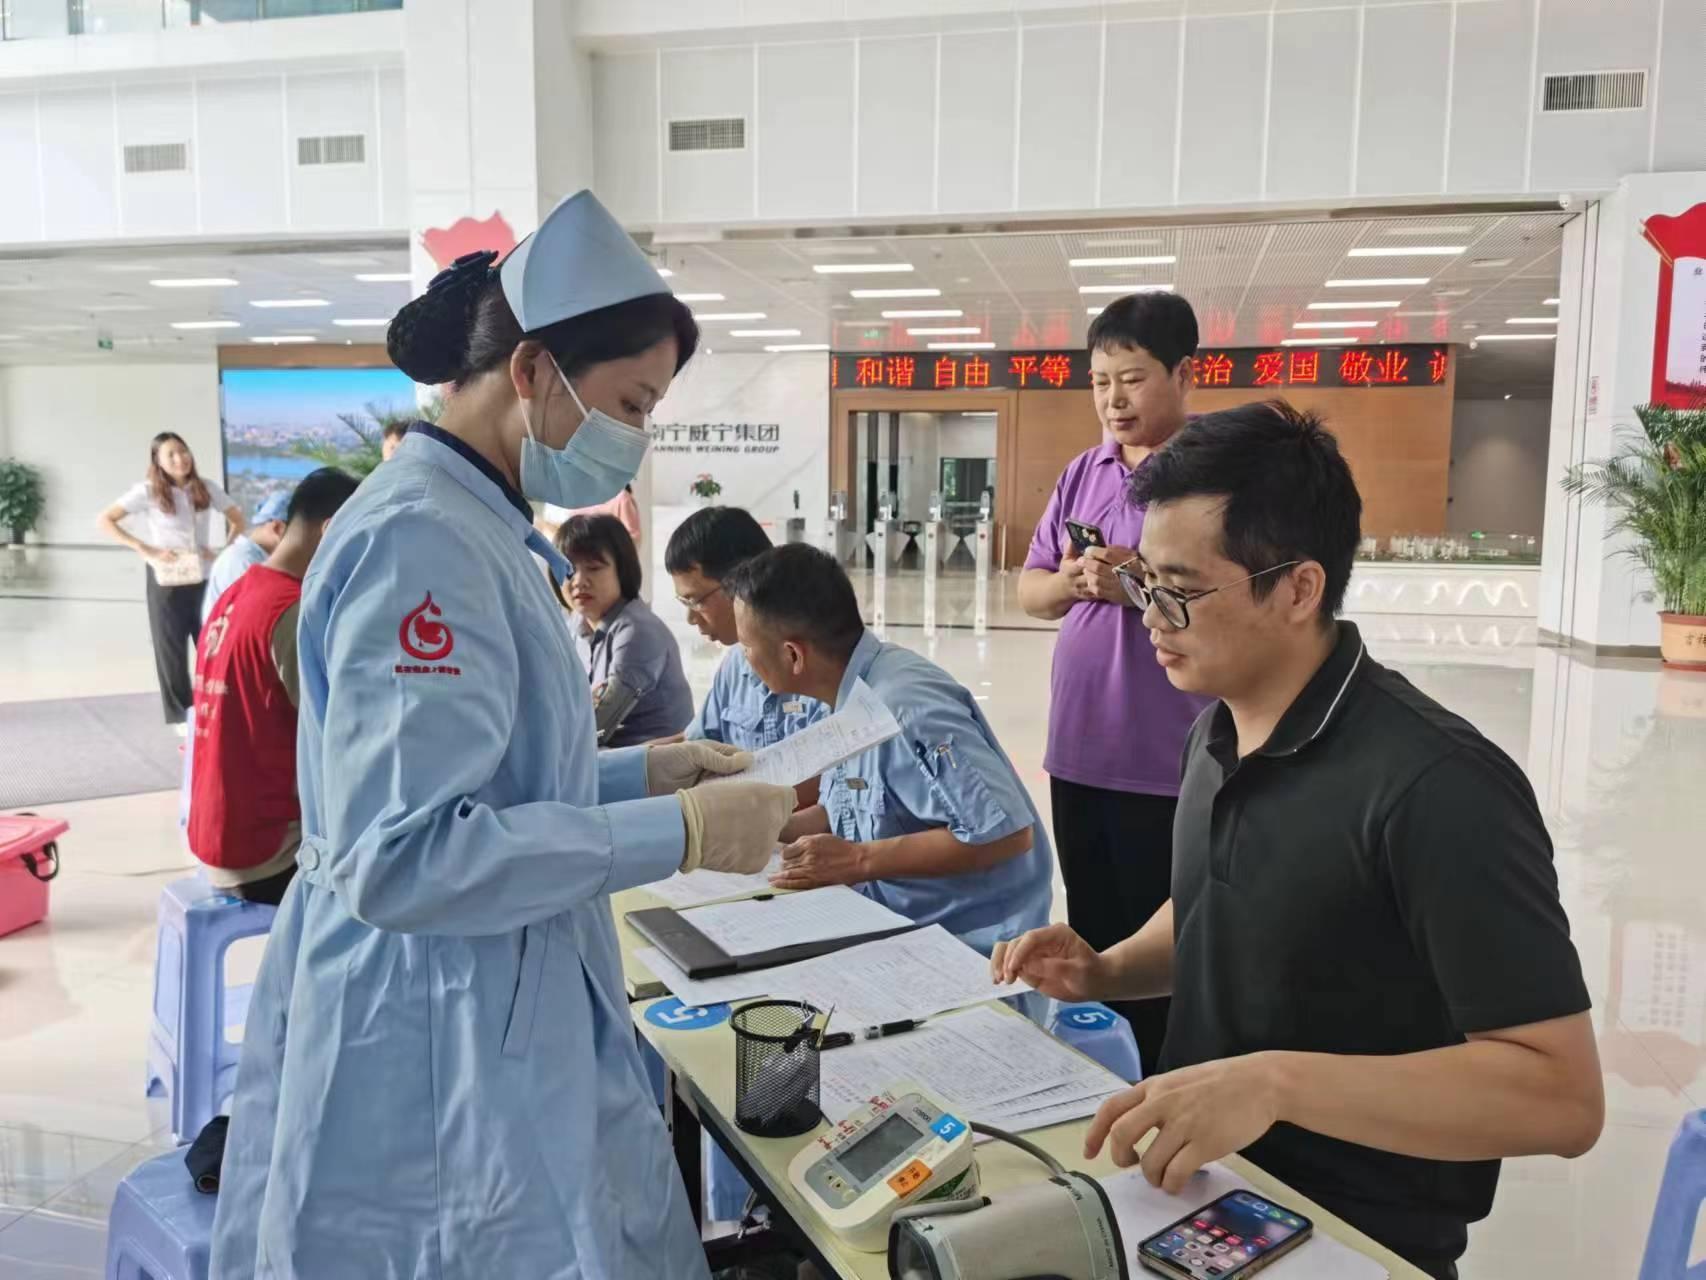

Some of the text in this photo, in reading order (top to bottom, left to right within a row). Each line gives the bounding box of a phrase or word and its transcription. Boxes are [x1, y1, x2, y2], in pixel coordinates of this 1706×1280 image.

[856, 355, 915, 387] 和谐
[934, 355, 990, 387] 自由
[1008, 354, 1071, 387] 平等
[1253, 351, 1319, 385] 爱国
[1338, 351, 1408, 384] 敬业
[653, 445, 780, 453] ANNING WEINING GROUP
[1073, 1011, 1109, 1023] 5
[940, 1121, 956, 1135] 5
